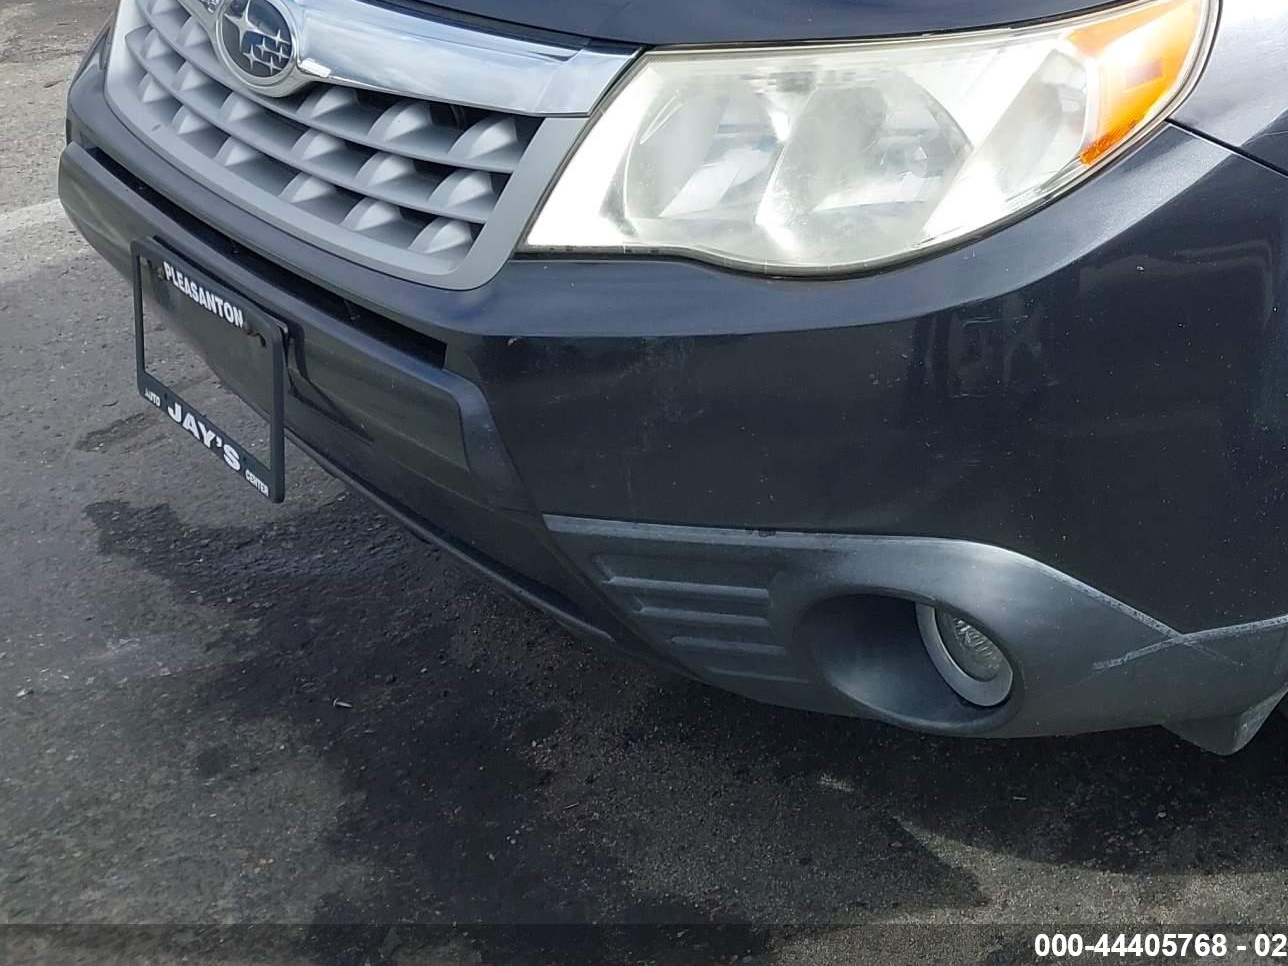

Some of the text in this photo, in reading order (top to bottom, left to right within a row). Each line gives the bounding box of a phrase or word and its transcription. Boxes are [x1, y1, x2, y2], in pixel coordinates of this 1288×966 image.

[163, 261, 244, 329] PLEASANTON
[144, 389, 269, 498] AUTO JAY'S CENTER
